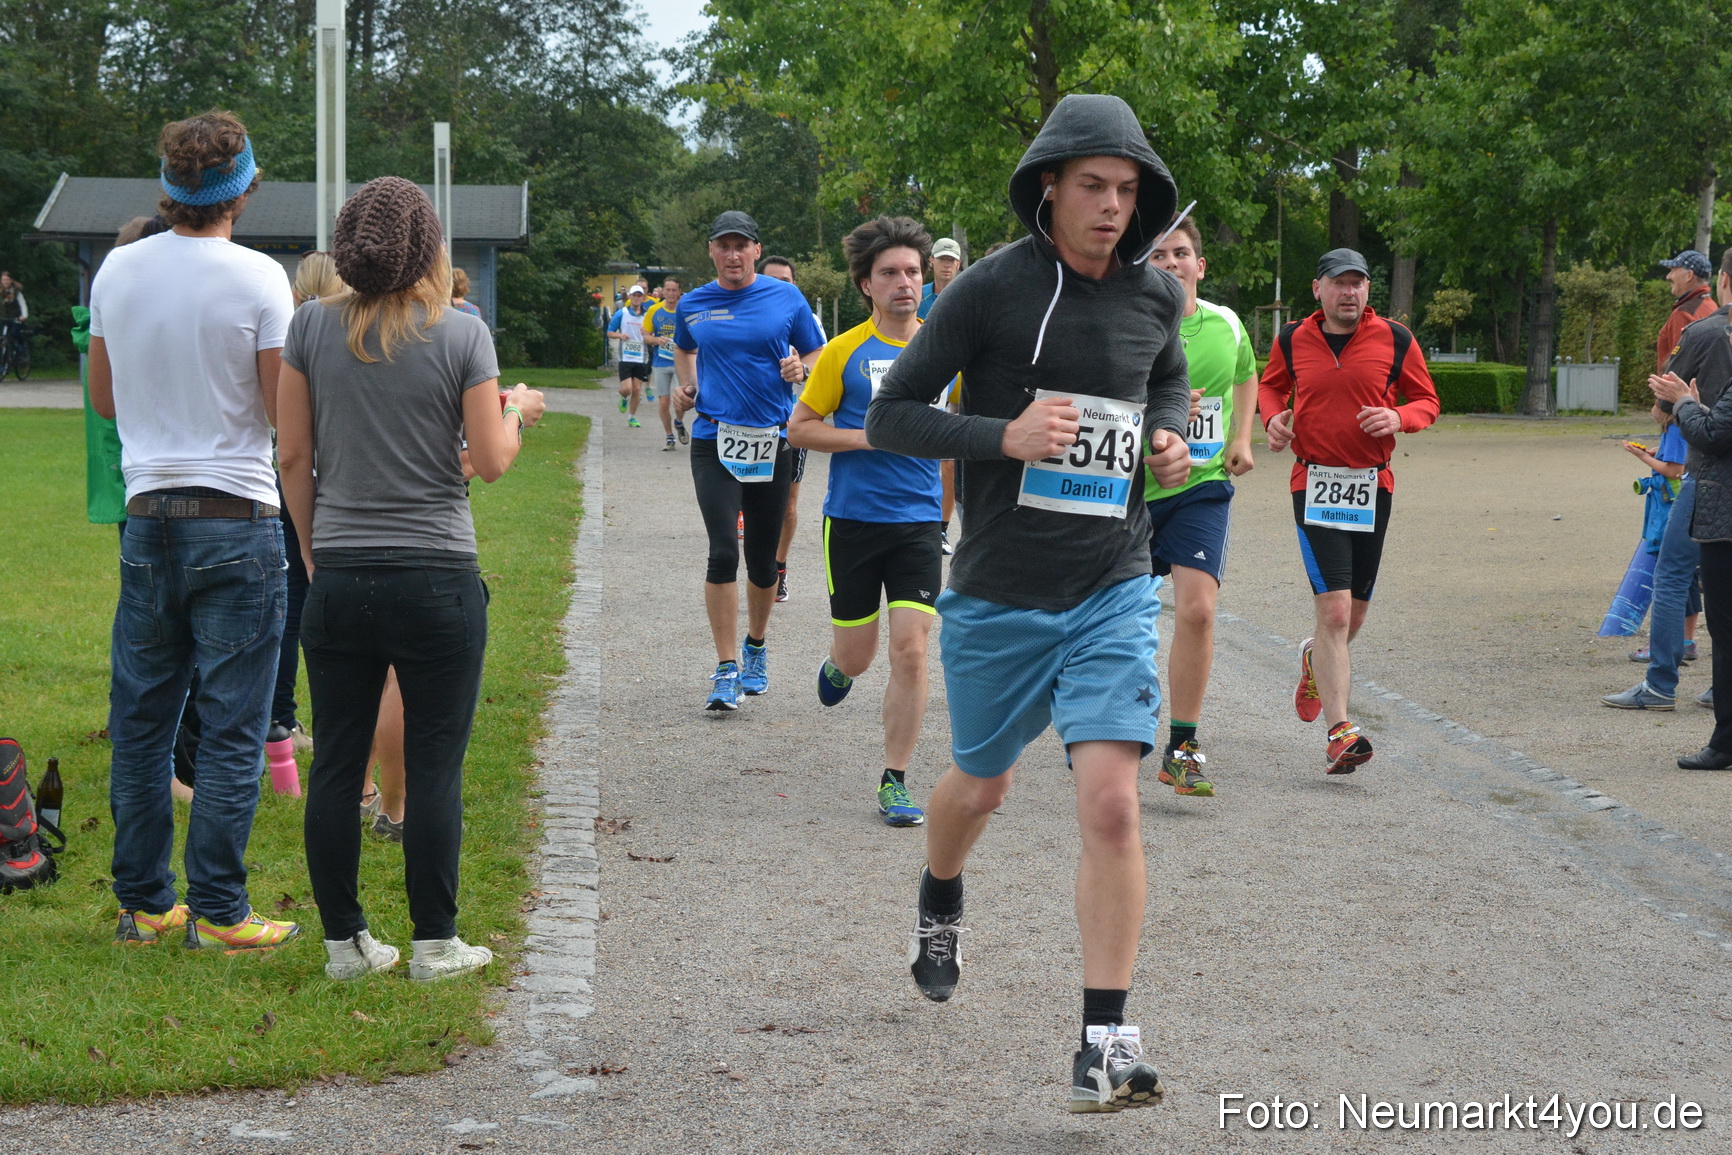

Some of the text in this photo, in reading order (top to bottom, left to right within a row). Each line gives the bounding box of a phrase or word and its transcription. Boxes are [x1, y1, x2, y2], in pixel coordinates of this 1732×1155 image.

[1082, 407, 1131, 424] Neumarkt
[723, 437, 773, 461] 2212
[1040, 425, 1135, 474] 543
[1189, 446, 1210, 459] toph
[1309, 470, 1366, 480] PARTL Neumarkt
[1060, 478, 1114, 499] Daniel
[1314, 481, 1370, 506] 2845
[1321, 510, 1359, 521] Matthias
